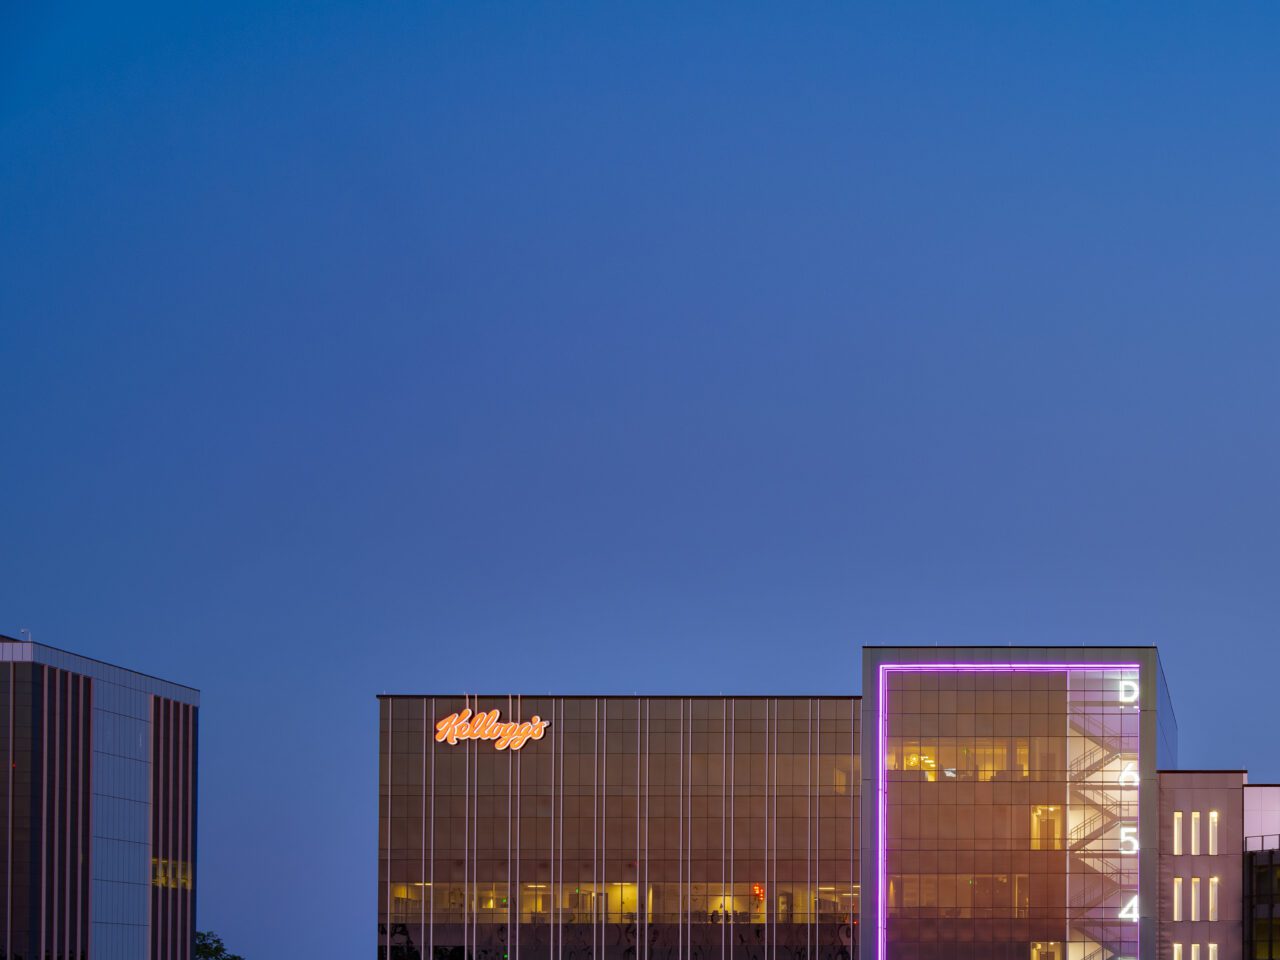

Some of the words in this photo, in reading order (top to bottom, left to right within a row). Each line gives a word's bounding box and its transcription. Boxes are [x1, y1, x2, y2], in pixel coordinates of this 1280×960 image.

[1119, 680, 1140, 702] D
[435, 708, 546, 751] Kellogg's
[1119, 761, 1140, 788] 6
[1119, 827, 1140, 854] 5
[1118, 894, 1140, 922] 4
